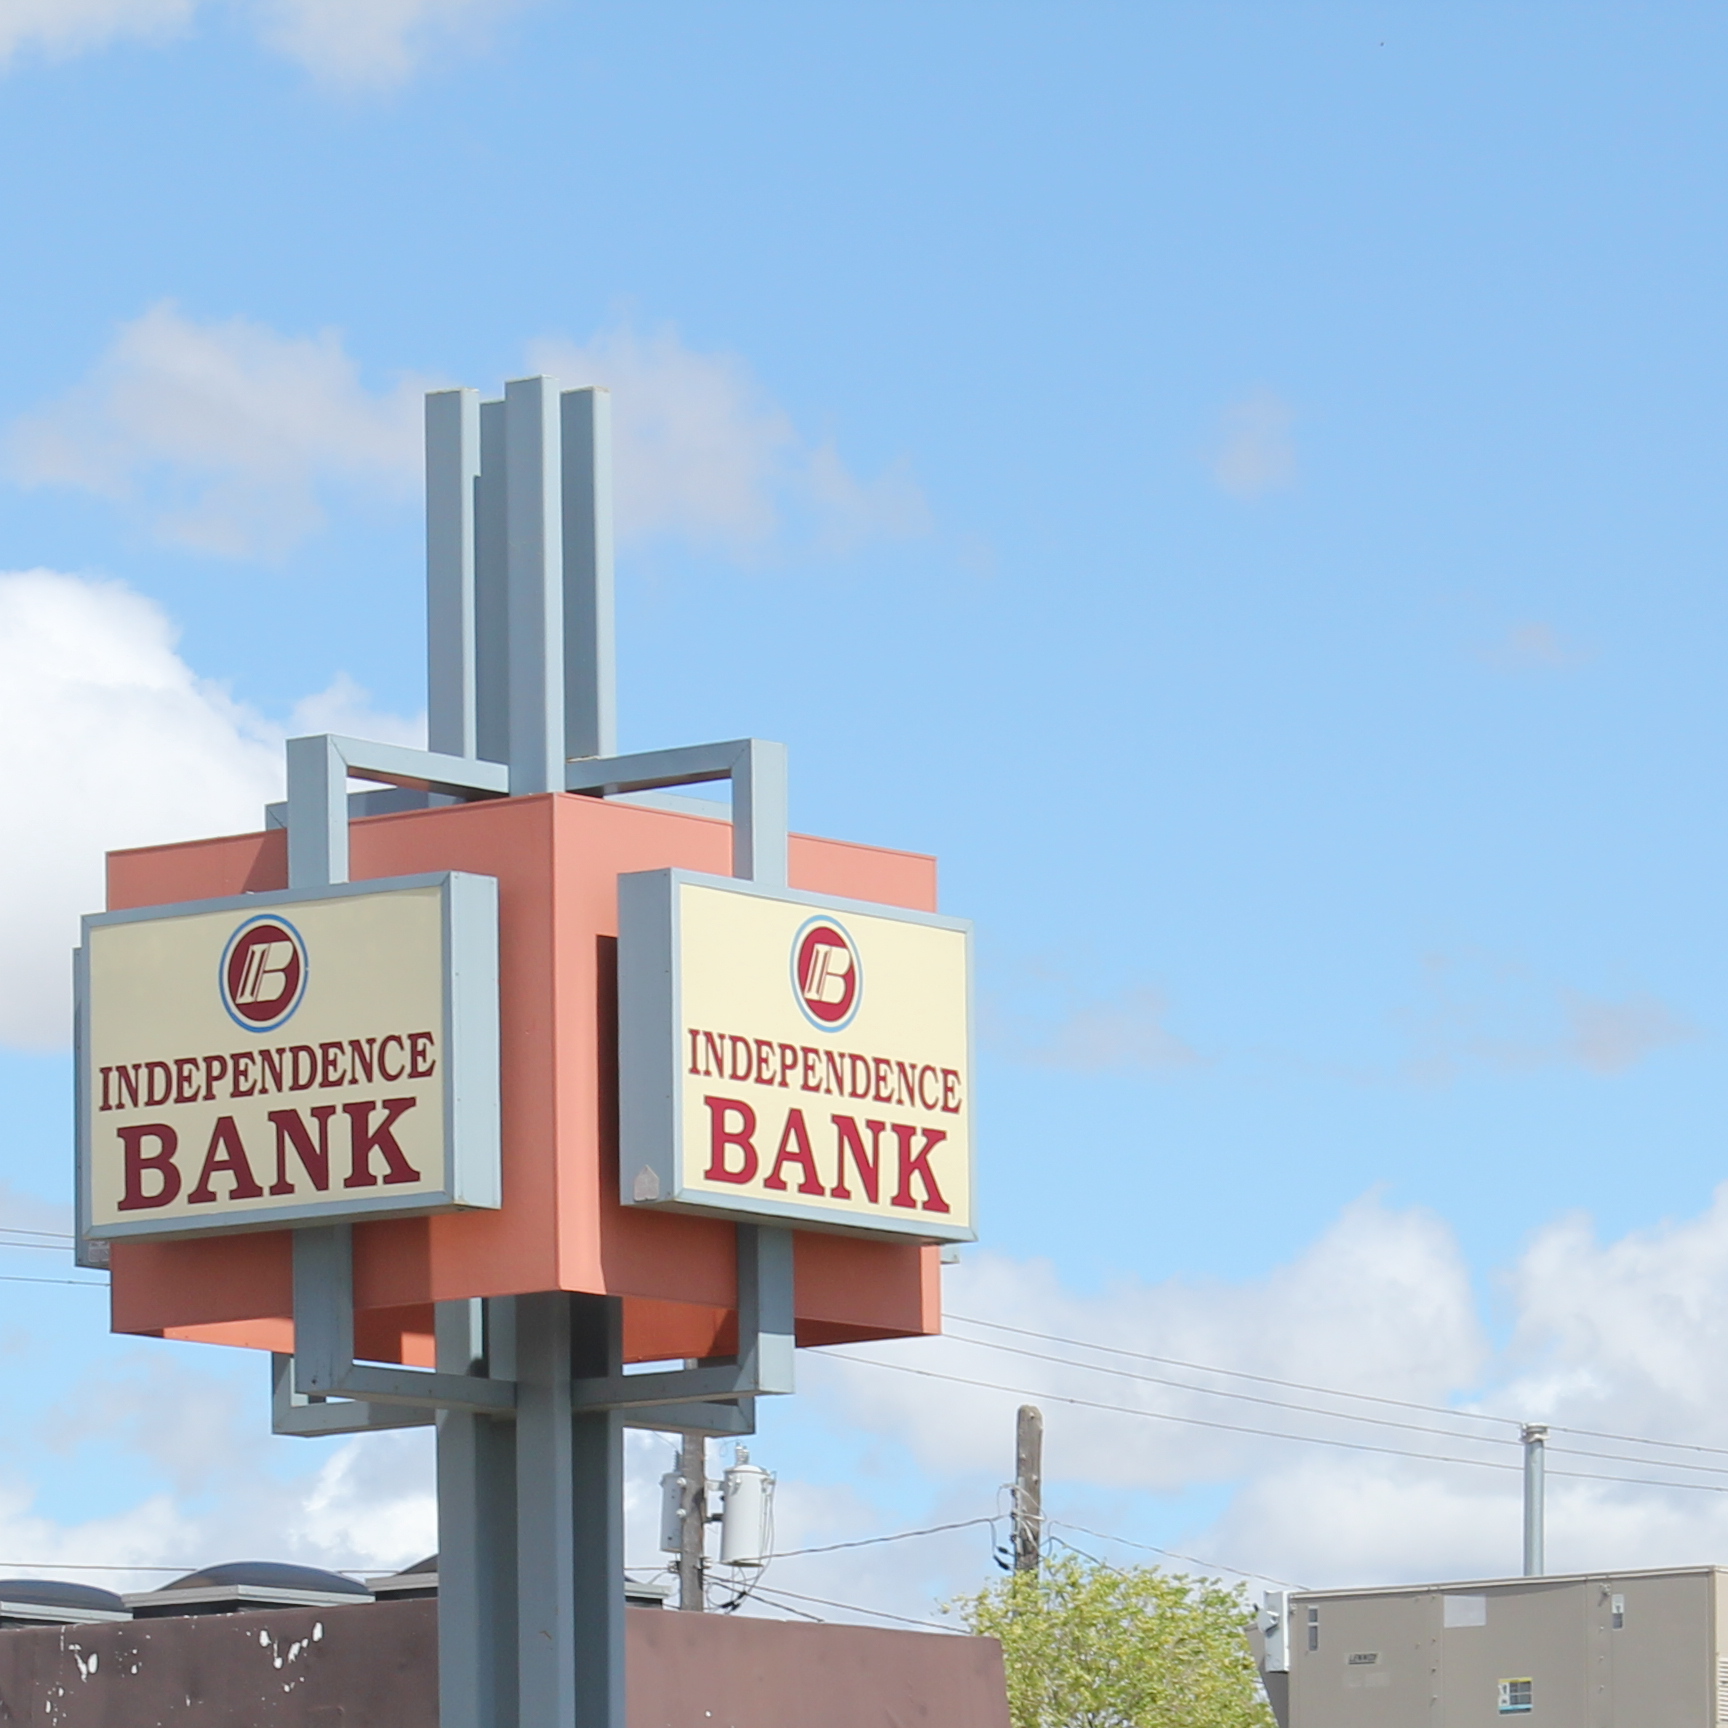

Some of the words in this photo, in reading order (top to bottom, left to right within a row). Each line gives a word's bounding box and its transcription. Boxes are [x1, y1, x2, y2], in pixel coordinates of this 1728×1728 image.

[99, 1031, 436, 1113] INDEPENDENCE
[688, 1028, 962, 1115] INDEPENDENCE
[116, 1096, 422, 1212] BANK
[703, 1095, 951, 1215] BANK
